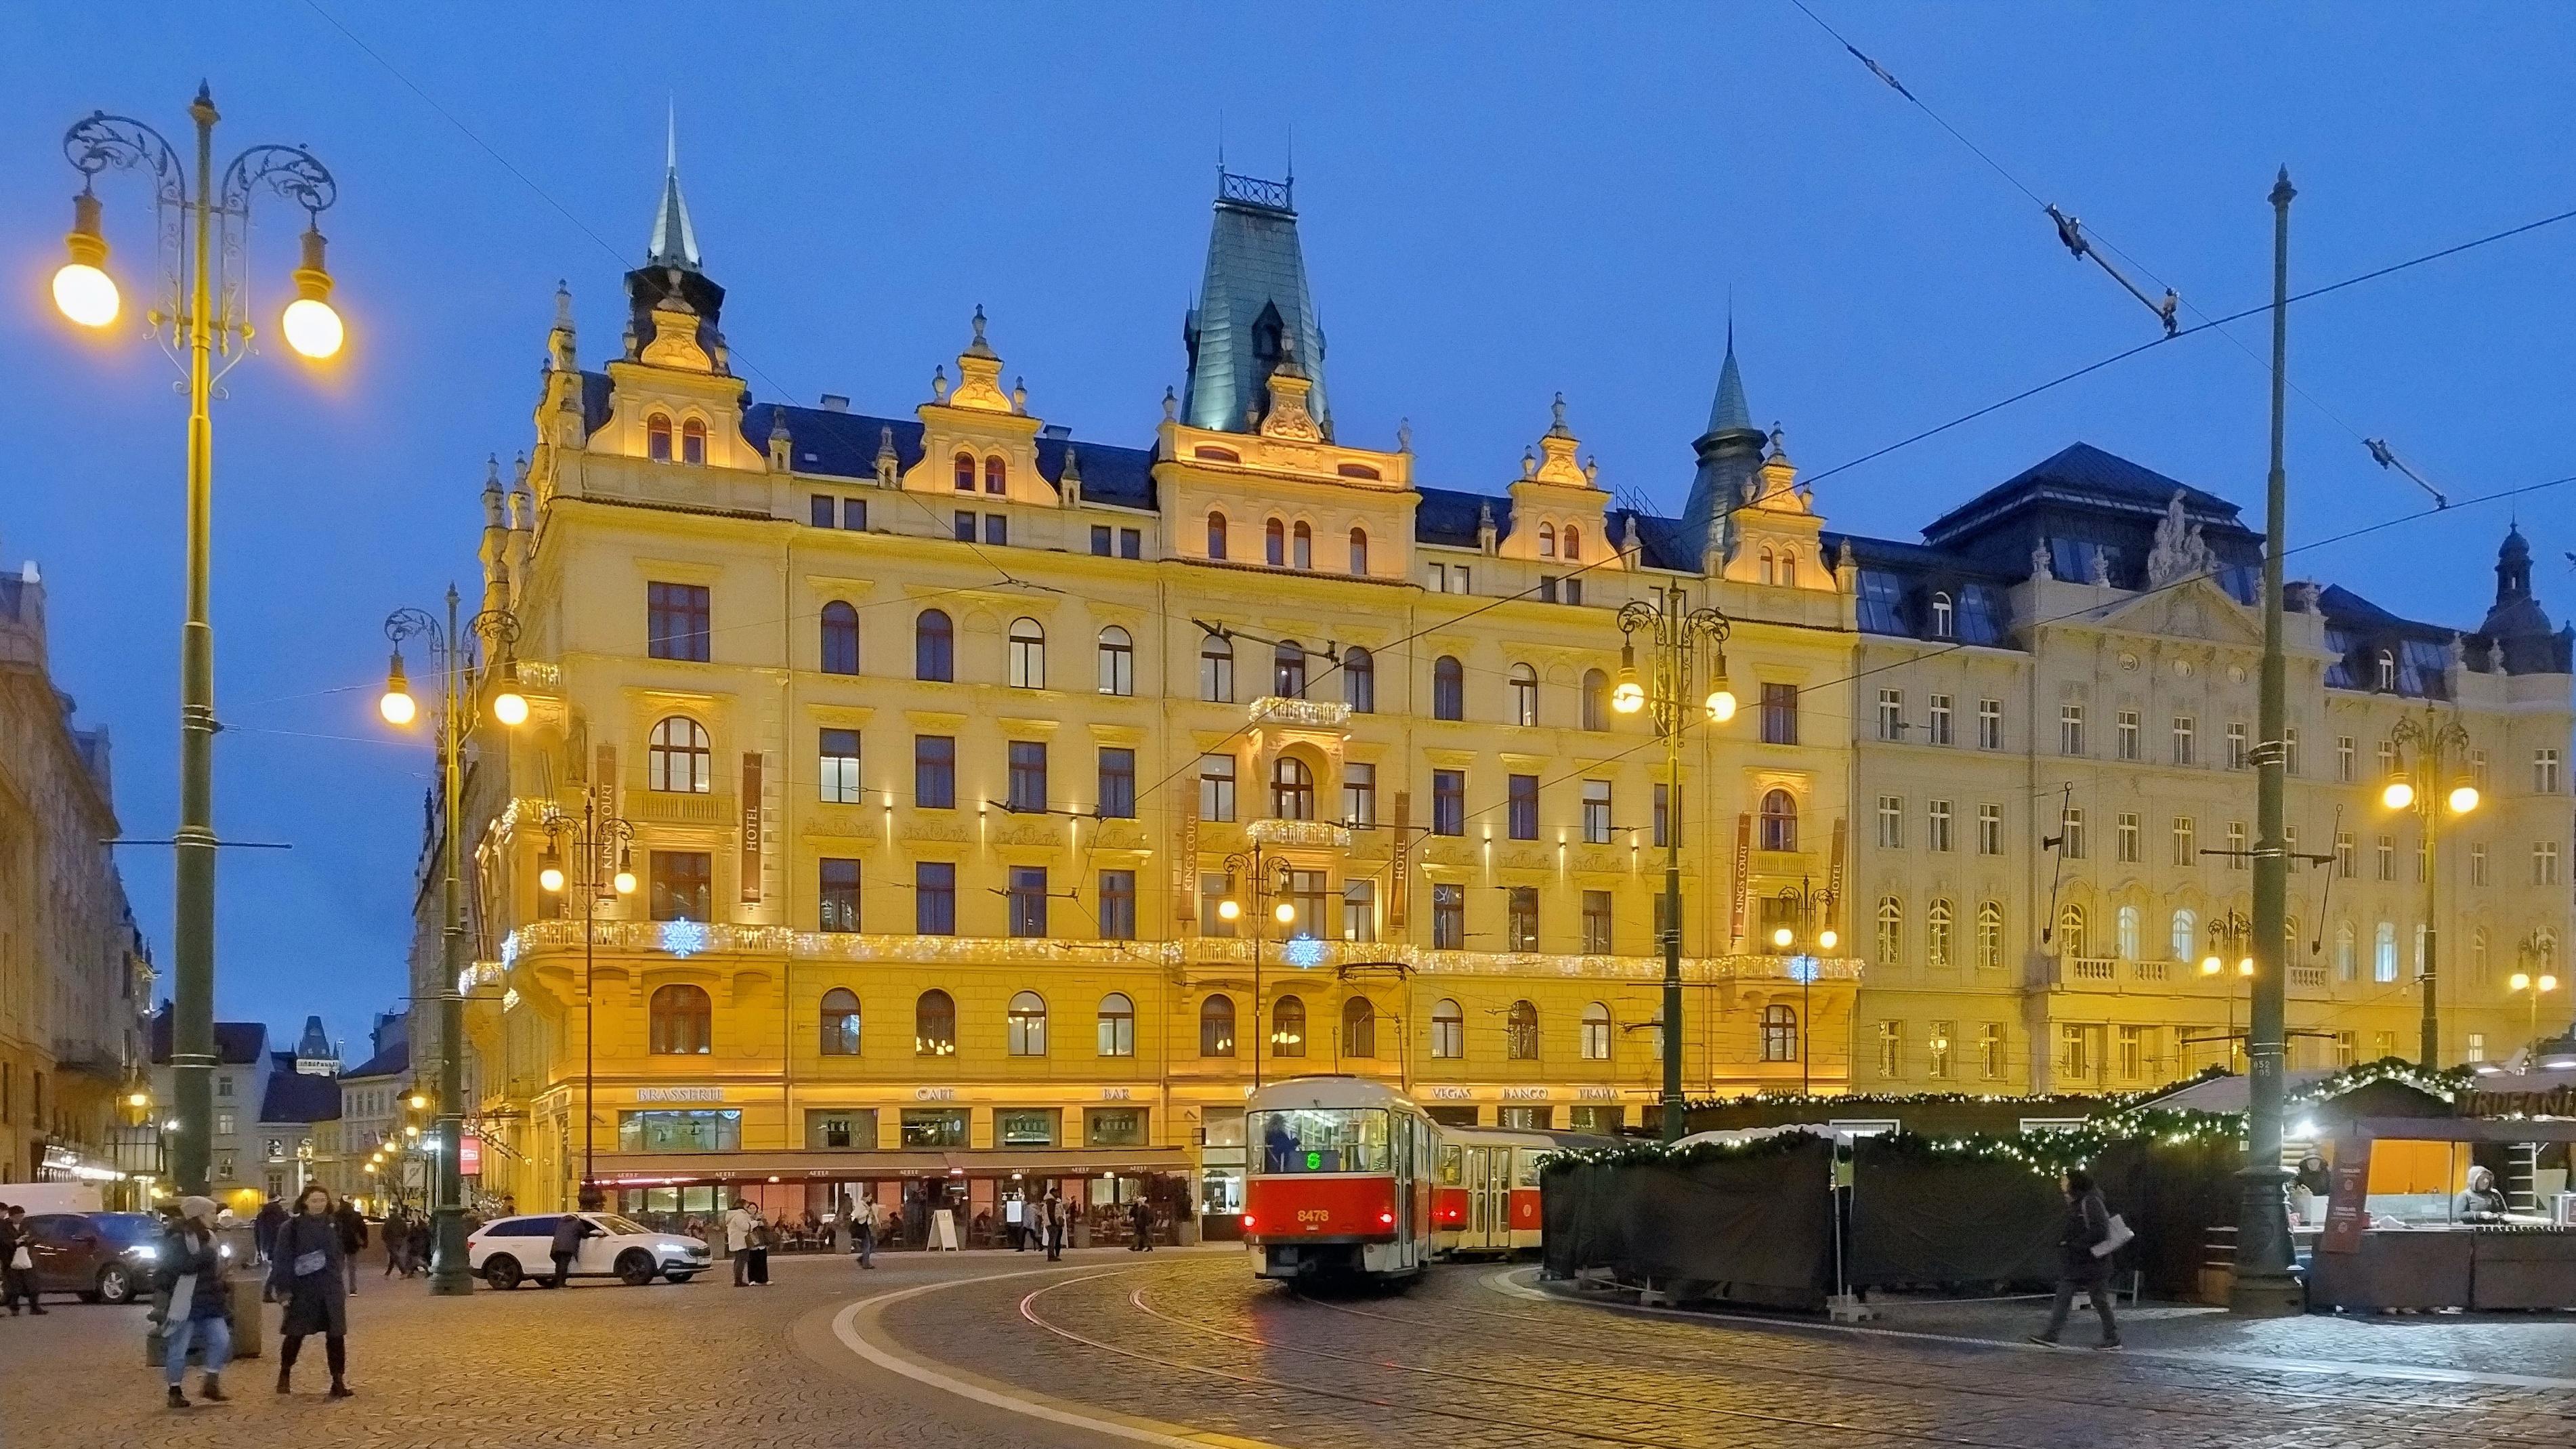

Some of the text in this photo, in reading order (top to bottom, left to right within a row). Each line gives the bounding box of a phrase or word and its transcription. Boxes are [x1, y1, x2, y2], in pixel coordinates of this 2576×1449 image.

[601, 782, 613, 824] COURT
[746, 805, 758, 852] HOTEL
[1184, 812, 1196, 891] KINGS COURT
[1395, 839, 1406, 880] HOTEL
[1735, 843, 1748, 913] KINGS COURT
[1831, 861, 1841, 898] HOTEL
[637, 1087, 724, 1101] BRASSERIE
[1103, 1087, 1131, 1100] BAR
[1431, 1086, 1619, 1099] VEGAS BANCO PRAHA
[1307, 1152, 1320, 1170] 6
[1297, 1210, 1329, 1222] 8478
